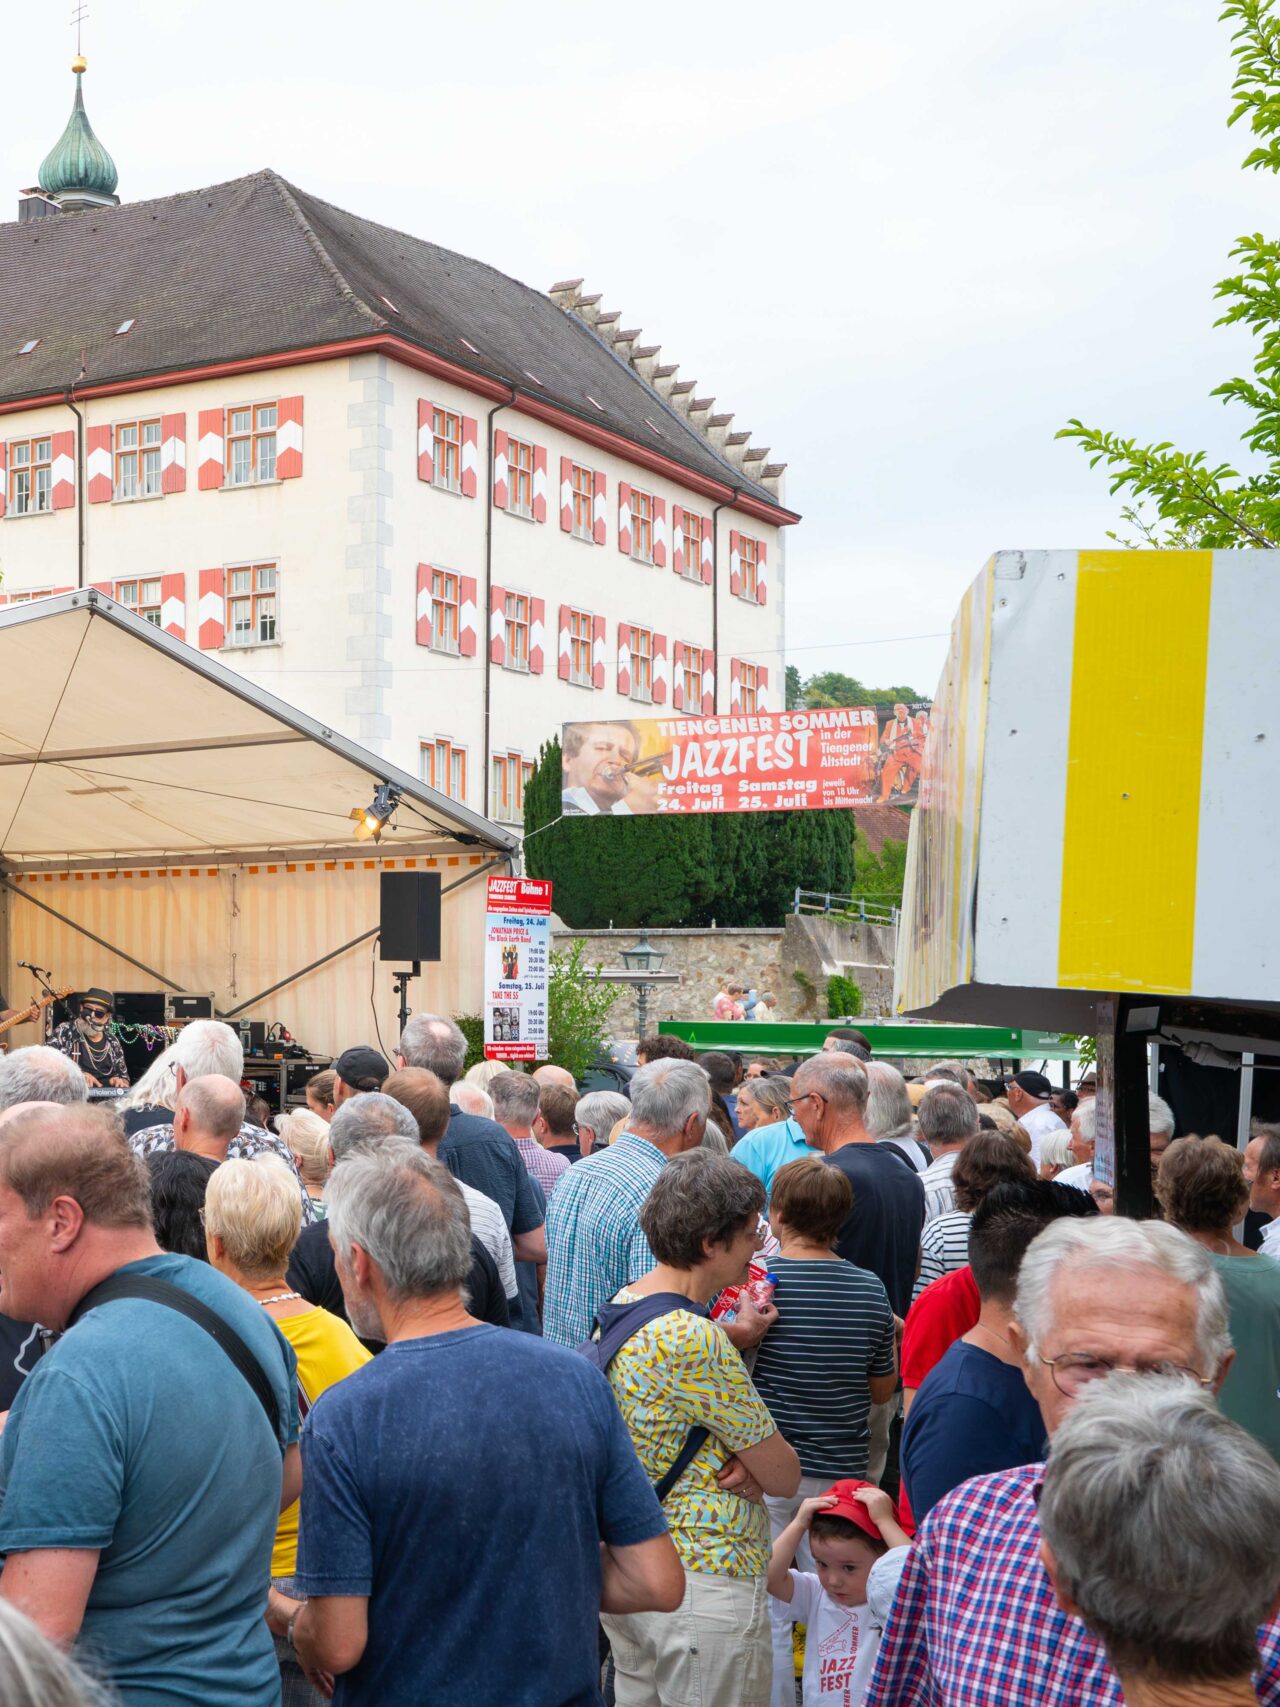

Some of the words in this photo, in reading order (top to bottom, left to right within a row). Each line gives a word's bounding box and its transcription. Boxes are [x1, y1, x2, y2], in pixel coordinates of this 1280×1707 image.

[657, 717, 774, 736] TIENGENER
[779, 710, 877, 731] SOMMER
[821, 730, 831, 739] in
[834, 729, 852, 739] der
[663, 729, 814, 781] JAZZFEST
[821, 742, 873, 755] Tiengener
[821, 755, 861, 767] Altstadt
[657, 781, 723, 796] Freitag
[738, 778, 818, 792] Samstag
[822, 778, 846, 789] jeweils
[847, 787, 860, 795] Uhr
[657, 798, 686, 811] 24.
[692, 796, 725, 810] Juli
[738, 796, 768, 809] 25.
[774, 793, 807, 807] Juli
[823, 797, 834, 805] bis
[835, 796, 873, 805] Mitternacht
[489, 880, 518, 893] JAZZFEST
[521, 882, 543, 895] Bühne
[544, 884, 548, 896] 1
[504, 917, 525, 926] Freitag,
[498, 982, 523, 991] Samstag,
[492, 991, 503, 999] TAKE
[820, 1656, 856, 1674] JAZZ
[820, 1672, 852, 1693] FEST
[843, 1689, 851, 1707] ENER
